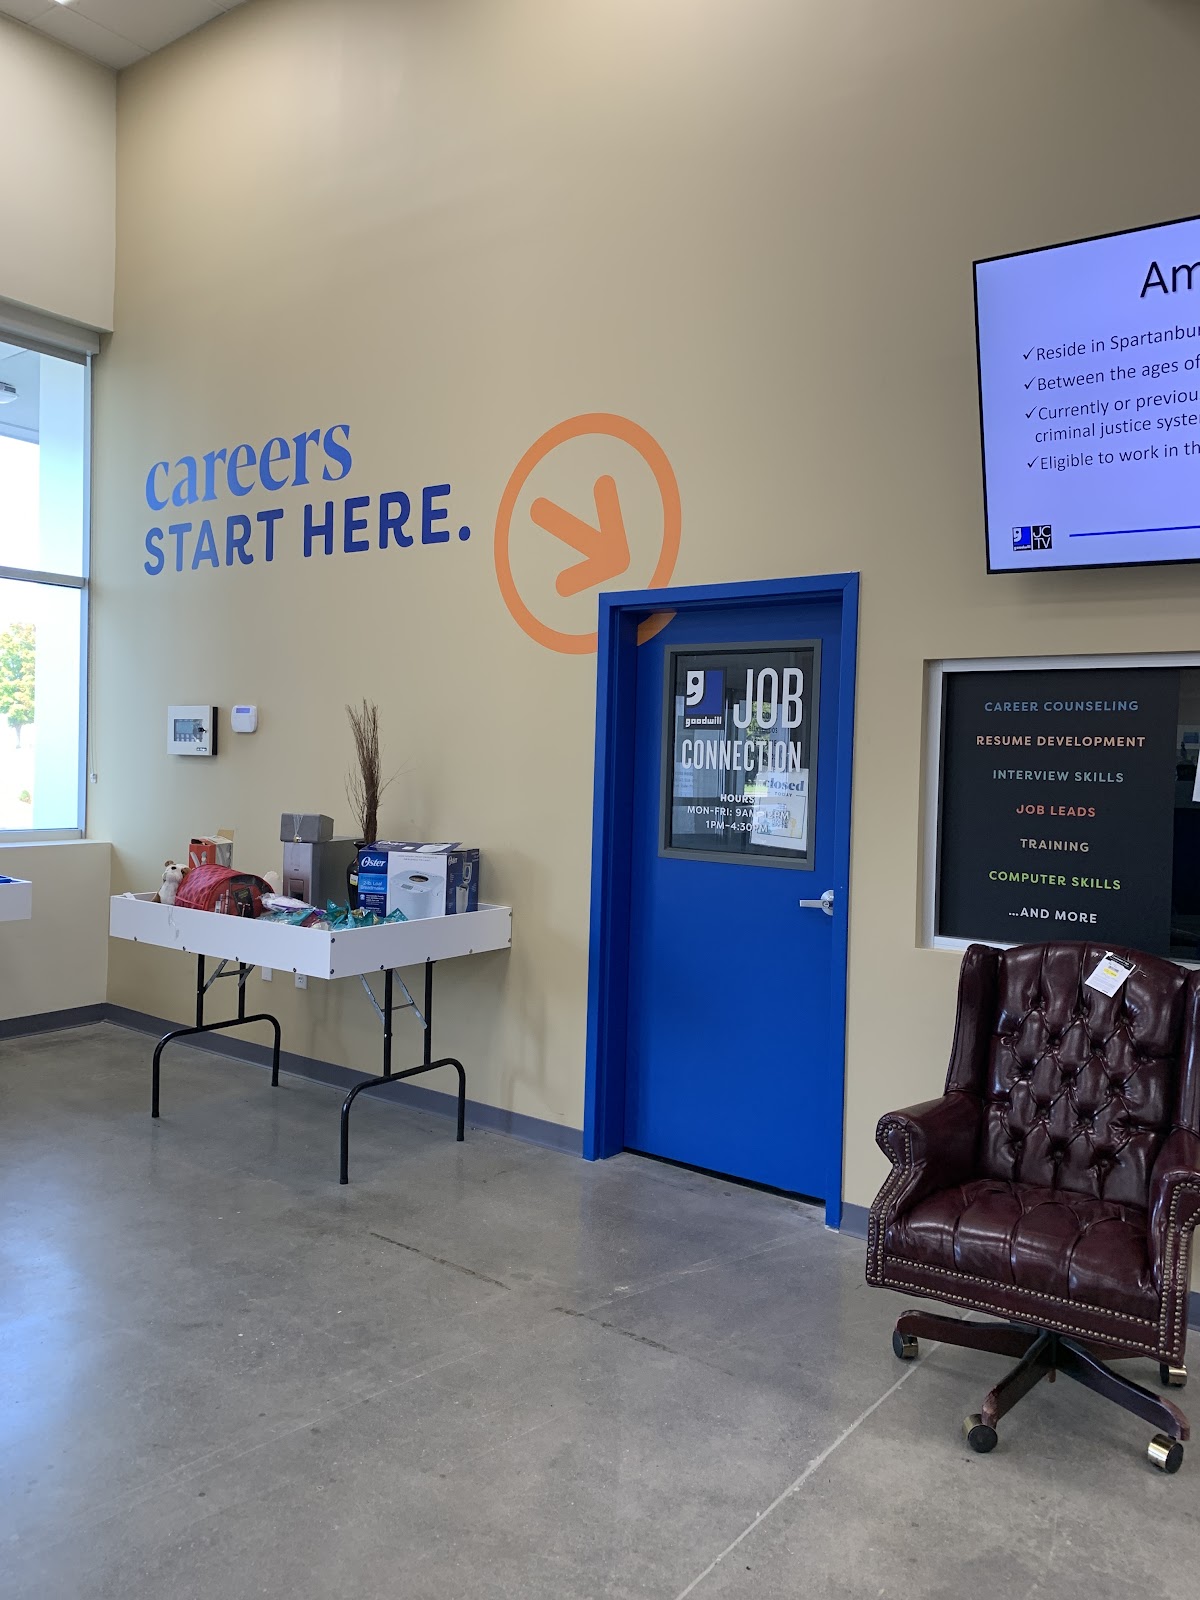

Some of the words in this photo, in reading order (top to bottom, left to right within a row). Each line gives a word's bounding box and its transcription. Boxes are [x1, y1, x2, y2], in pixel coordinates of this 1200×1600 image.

[1037, 342, 1086, 361] Reside
[1091, 339, 1105, 353] in
[1037, 371, 1104, 391] Between
[1110, 366, 1136, 381] the
[1141, 360, 1179, 378] ages
[1184, 354, 1200, 371] of
[1038, 400, 1109, 420] Currently
[1114, 398, 1131, 411] or
[1035, 423, 1095, 443] criminal
[1100, 419, 1151, 439] justice
[1156, 413, 1200, 432] syste
[1040, 452, 1093, 472] Eligible
[1098, 452, 1114, 465] to
[1119, 445, 1159, 462] work
[1164, 444, 1178, 458] in
[145, 424, 352, 511] careers
[144, 508, 284, 576] START
[303, 483, 471, 558] HERE.
[1033, 526, 1051, 538] JC
[1033, 537, 1051, 549] TV
[733, 667, 804, 729] JOB
[984, 701, 1039, 713] CAREER
[1043, 700, 1139, 712] COUNSELING
[684, 716, 722, 728] goodwill
[976, 735, 1032, 746] RESUME
[1037, 736, 1146, 748] DEVELOPMENT
[681, 739, 802, 773] CONNECTION
[992, 769, 1069, 782] INTERVIEW
[1074, 771, 1124, 783] SKILLS
[764, 780, 805, 792] closed
[687, 805, 733, 817] MON-FRI:
[1016, 804, 1045, 815] JOB
[1050, 805, 1096, 818] LEADS
[1020, 838, 1090, 853] TRAINING
[361, 856, 386, 868] Oster
[988, 870, 1067, 886] COMPUTER
[1071, 876, 1121, 890] SKILLS
[1055, 910, 1098, 924] MORE
